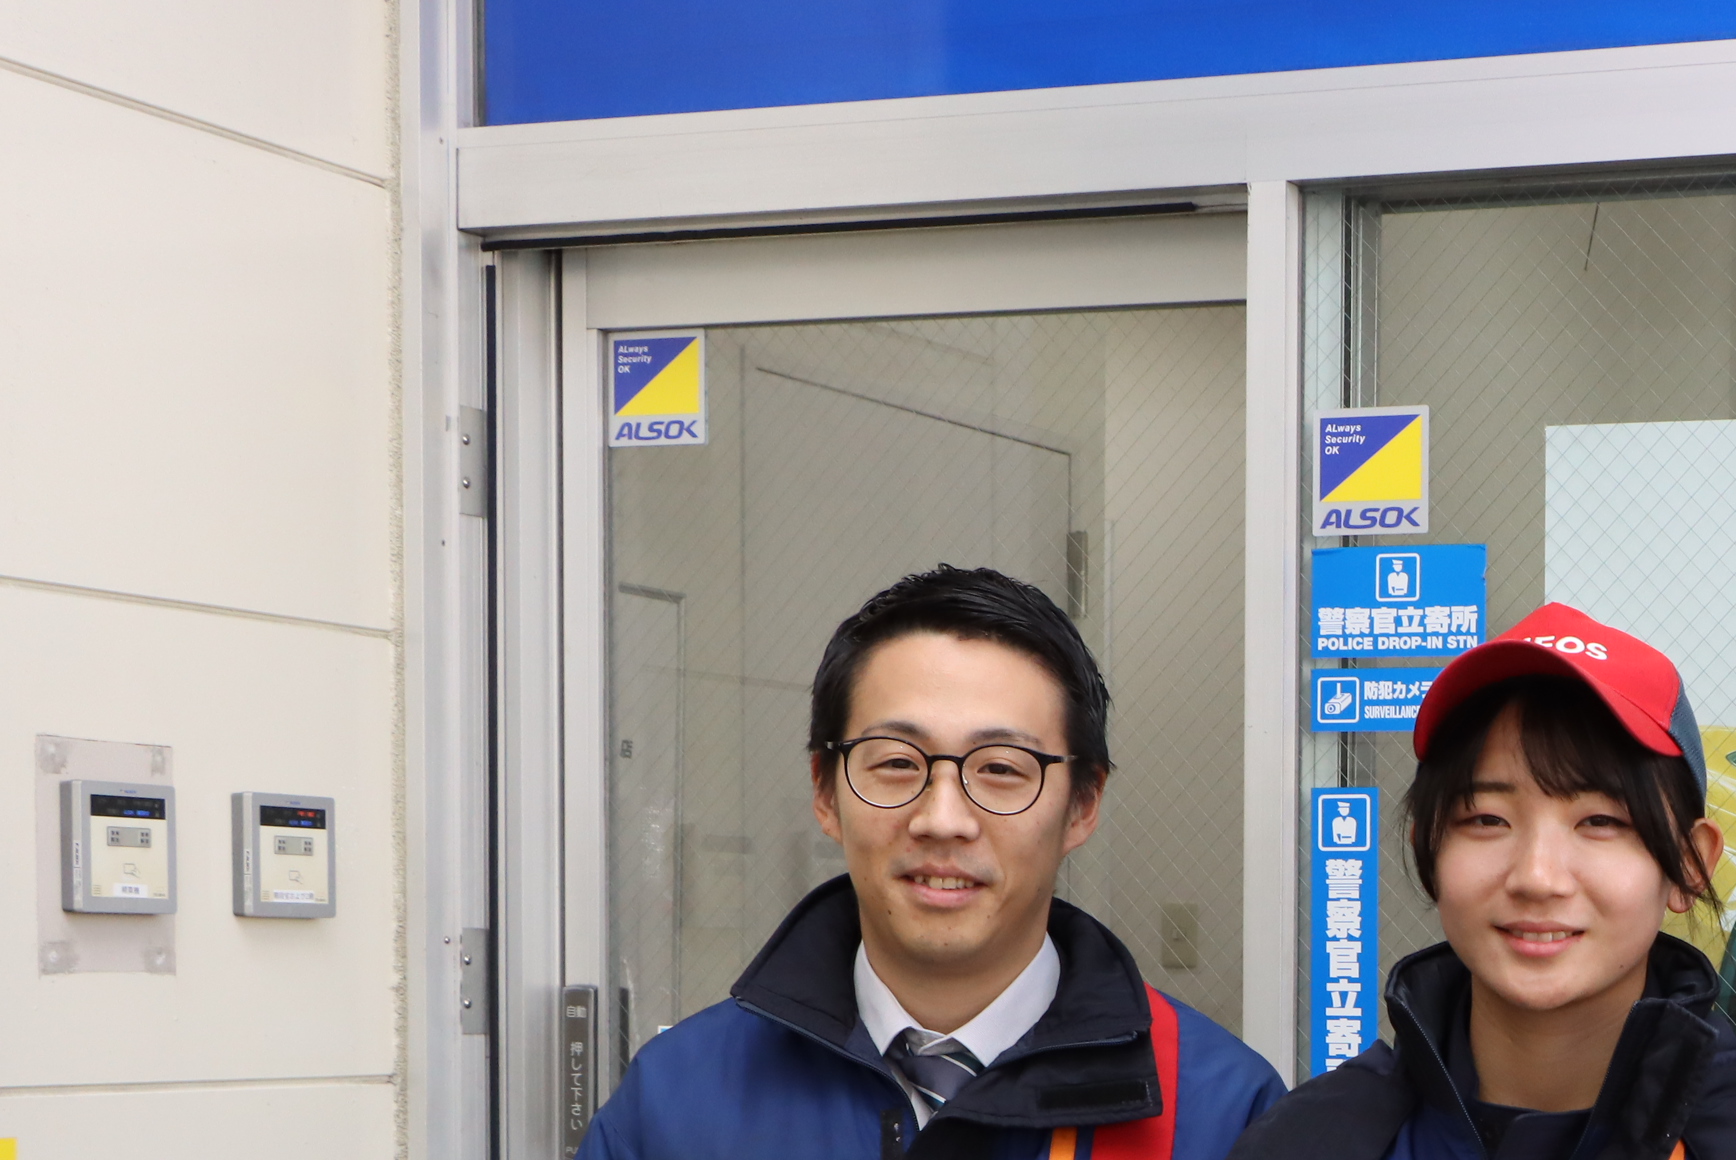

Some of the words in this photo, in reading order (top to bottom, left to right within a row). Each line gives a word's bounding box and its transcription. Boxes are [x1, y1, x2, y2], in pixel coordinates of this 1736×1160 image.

[618, 354, 653, 365] Security
[618, 365, 631, 374] OK
[615, 420, 699, 441] ALSOK
[1324, 434, 1366, 445] Security
[1324, 446, 1340, 455] OK
[1320, 506, 1421, 530] ALSOK
[1317, 605, 1478, 636] 警察官立寄所
[1317, 636, 1374, 651] POLICE
[1378, 636, 1444, 650] DROP-IN
[1447, 635, 1478, 649] STN
[566, 1005, 587, 1018] 自動
[570, 1041, 584, 1131] 押して下さい
